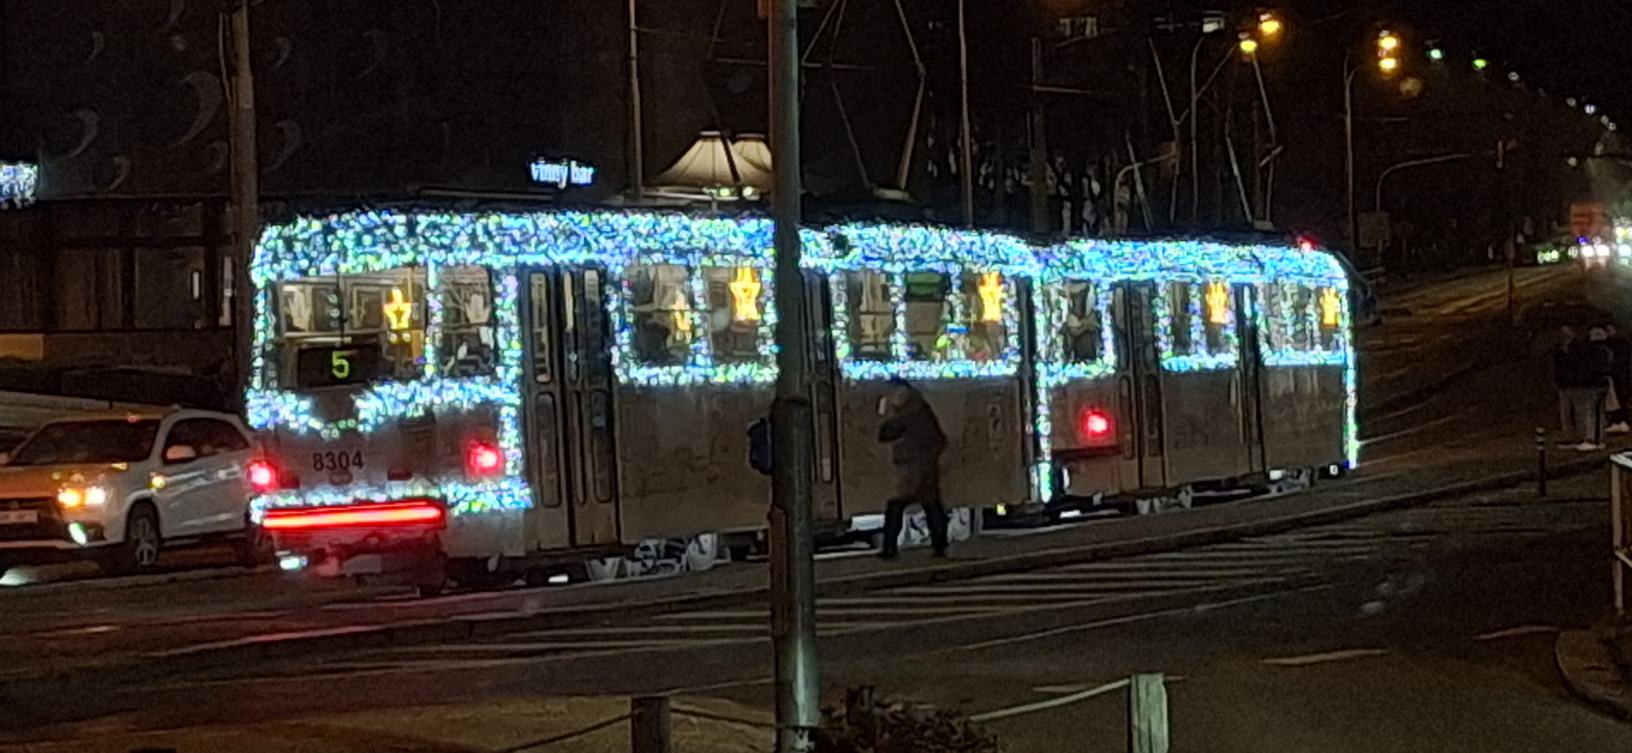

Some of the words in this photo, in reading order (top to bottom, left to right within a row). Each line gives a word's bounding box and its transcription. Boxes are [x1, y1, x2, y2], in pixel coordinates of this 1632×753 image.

[570, 160, 594, 184] bar
[332, 350, 350, 379] 5
[312, 449, 365, 472] 8304
